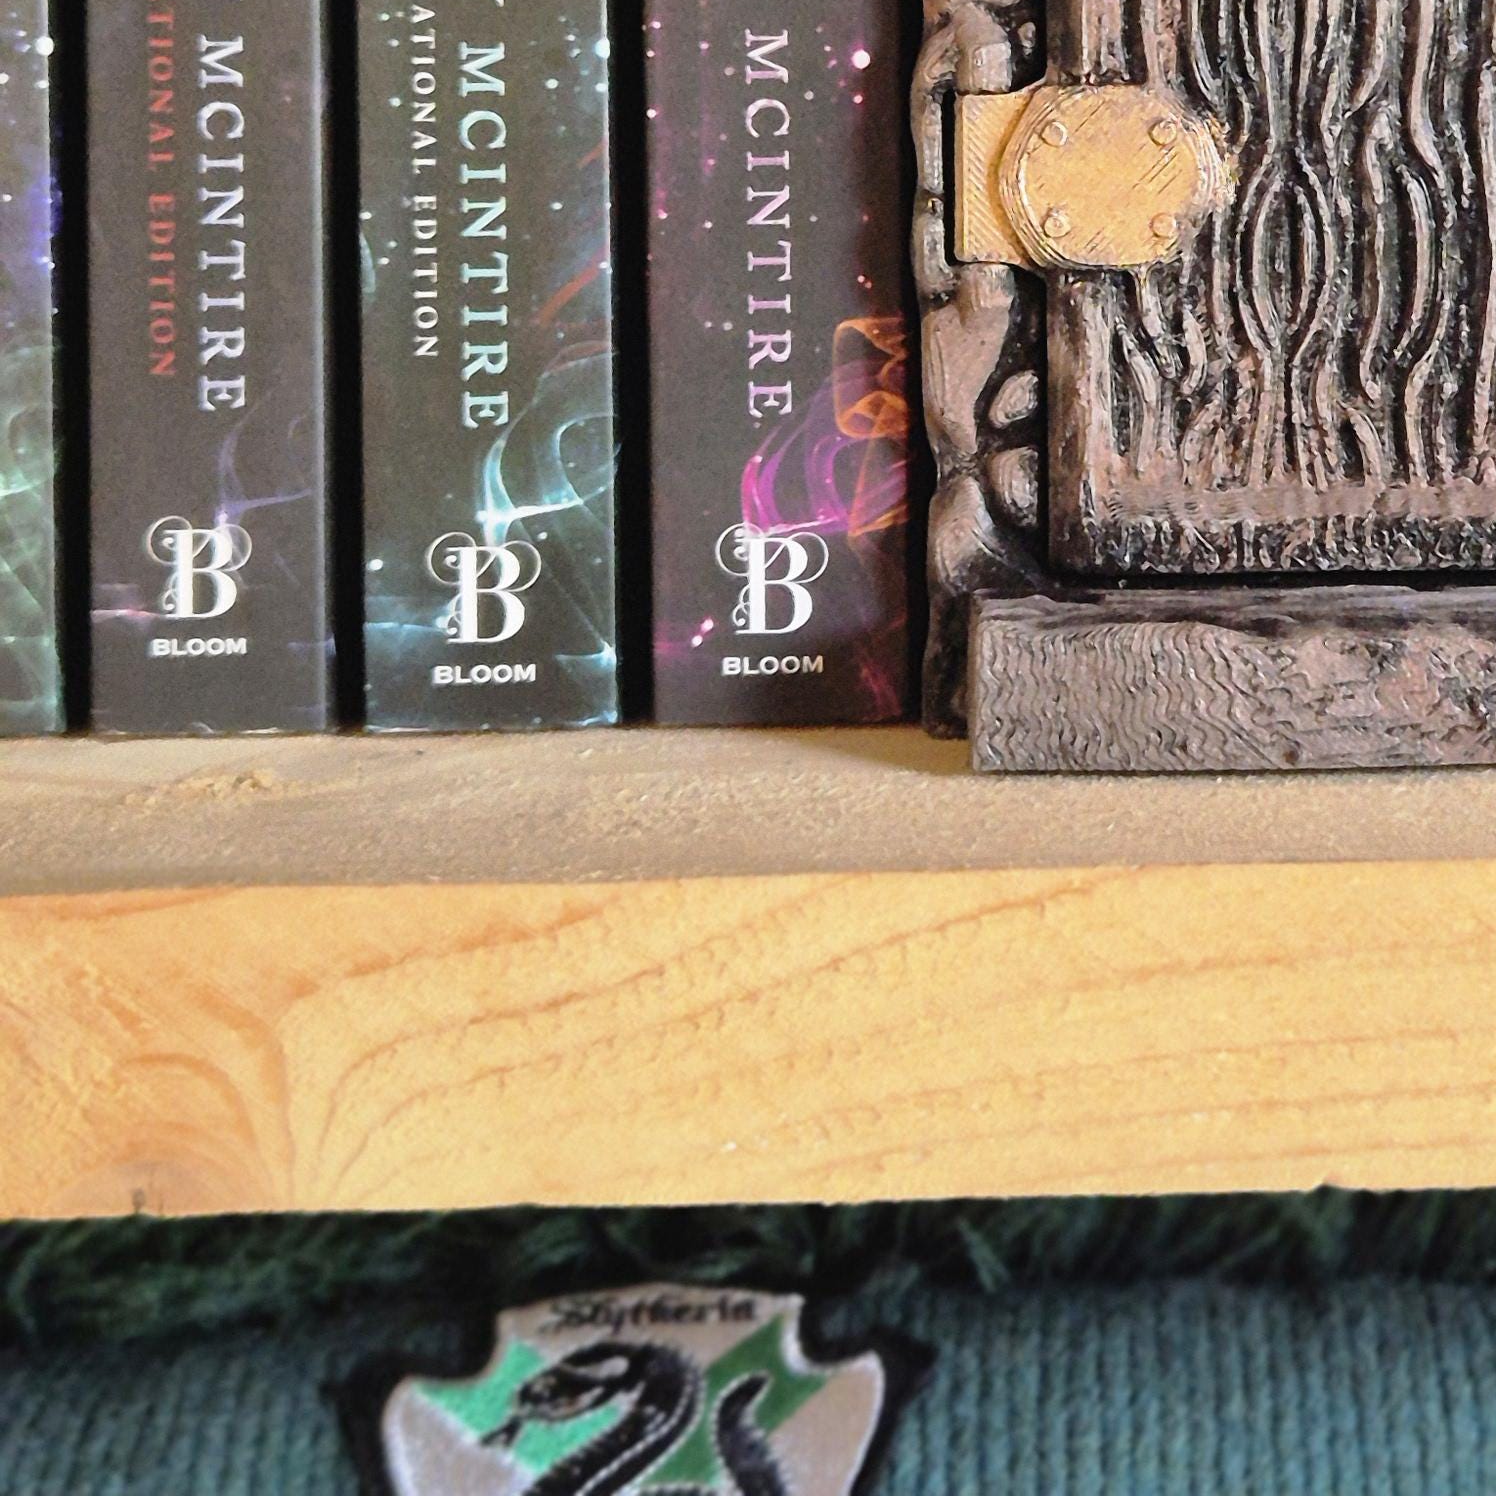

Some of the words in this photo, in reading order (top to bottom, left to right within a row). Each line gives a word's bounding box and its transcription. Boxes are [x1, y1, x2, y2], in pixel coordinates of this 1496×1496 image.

[199, 34, 246, 412] MCINTIRE
[412, 198, 439, 358] EDITION
[457, 44, 509, 429] MCINTIRE
[742, 32, 792, 418] MCINTIRE
[149, 198, 176, 377] EDITION
[146, 515, 253, 618] B
[427, 532, 542, 644] B
[715, 522, 829, 634] B
[152, 637, 248, 656] BLOOM
[433, 664, 537, 685] BLOOM
[721, 655, 824, 675] BLOOM
